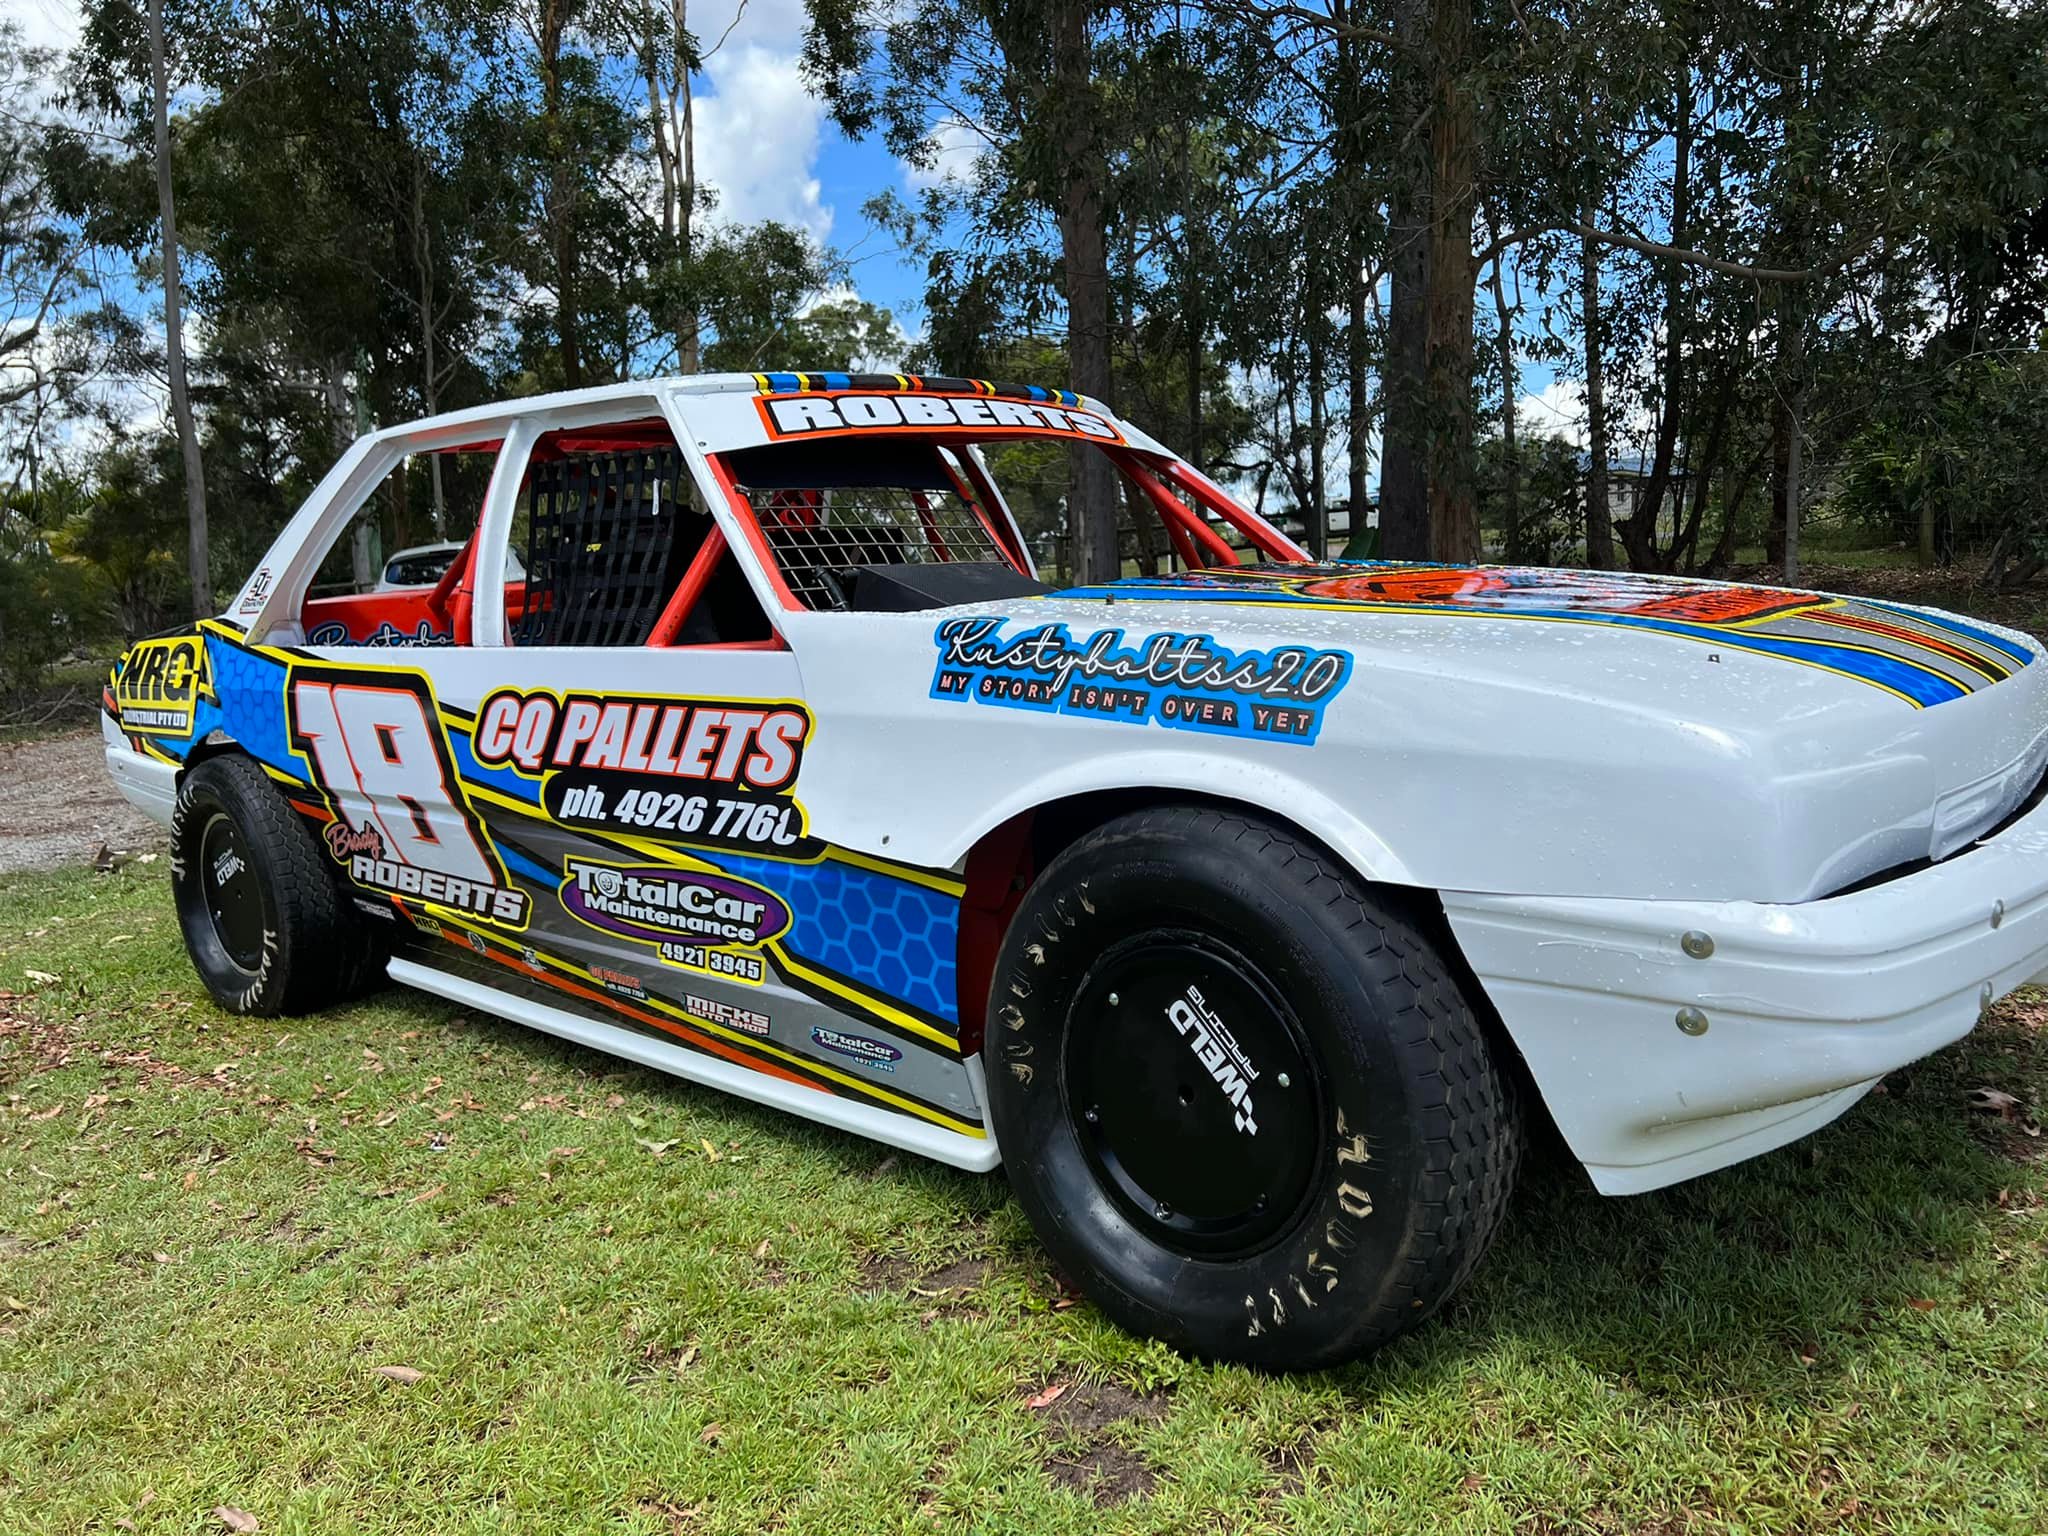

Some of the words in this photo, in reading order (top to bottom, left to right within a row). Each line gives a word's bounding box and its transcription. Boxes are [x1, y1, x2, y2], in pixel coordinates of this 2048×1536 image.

[770, 396, 1118, 439] ROBERTS
[119, 642, 196, 701] NRG
[940, 675, 967, 690] MY
[982, 679, 1054, 700] STORY
[1072, 688, 1143, 711] ISN'T
[1165, 700, 1233, 722] OVER
[1257, 709, 1309, 730] YET
[479, 696, 555, 769] CQ
[552, 700, 806, 786] PALLETS
[296, 680, 497, 887] 18
[559, 784, 606, 820] ph.
[613, 788, 707, 833] 4926
[353, 855, 524, 921] ROBERTS
[584, 893, 756, 943] Maintenance
[661, 942, 705, 967] 4921
[710, 952, 762, 981] 3945
[685, 994, 771, 1029] MICKS
[1169, 999, 1252, 1108] WELD
